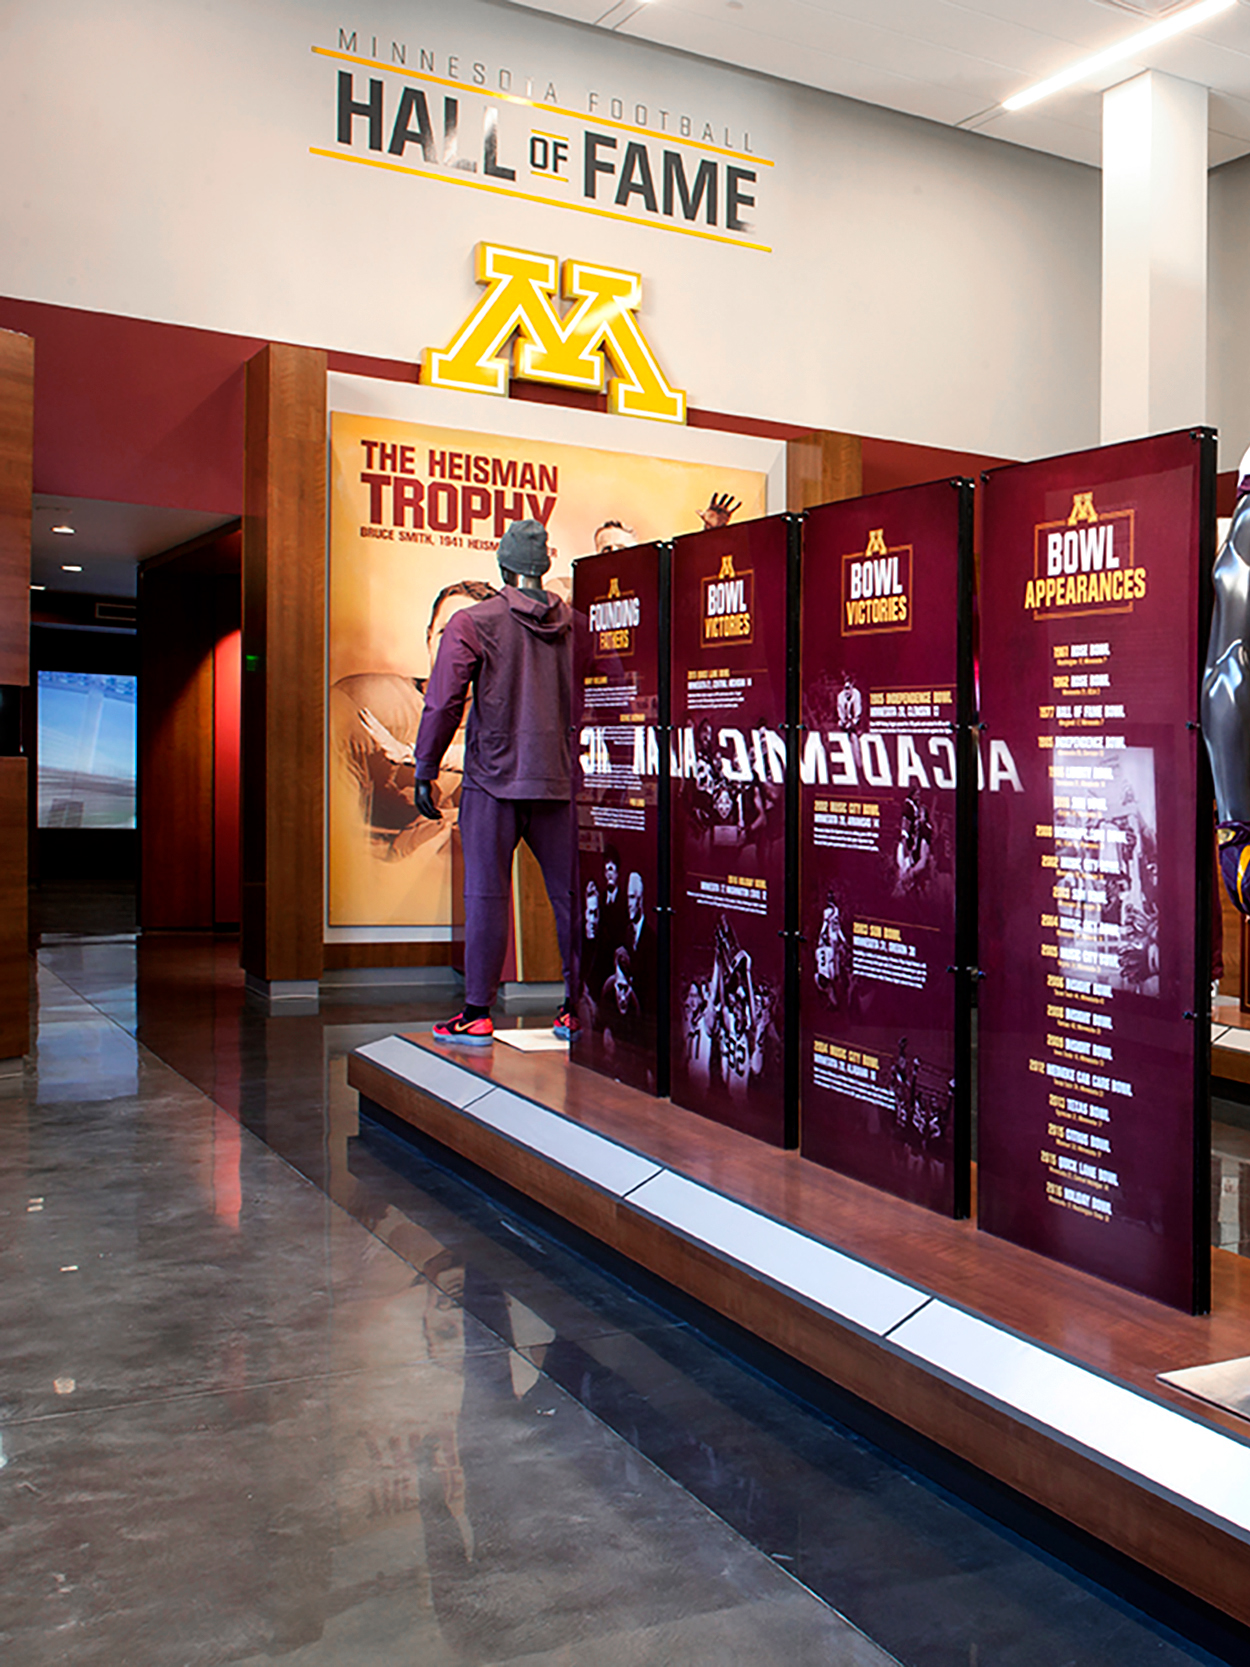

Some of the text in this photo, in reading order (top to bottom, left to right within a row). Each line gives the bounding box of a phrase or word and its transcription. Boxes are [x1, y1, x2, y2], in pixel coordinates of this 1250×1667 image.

[339, 28, 753, 154] MINNESOTA FOOTBALL
[337, 70, 757, 233] HALL OF FAME
[361, 440, 558, 493] THE HEISMAN
[360, 473, 558, 537] TROPHY
[360, 527, 395, 542] BRUCE
[439, 535, 464, 549] 1941
[468, 541, 500, 553] HEISM
[1047, 525, 1119, 577] BOWL
[707, 580, 747, 616] BOWL
[850, 556, 903, 600] BOWL
[1025, 568, 1146, 609] APPEARANCES
[589, 597, 640, 633] FOUNDING
[705, 613, 751, 639] VICTORIES
[846, 595, 907, 627] VICTORIES
